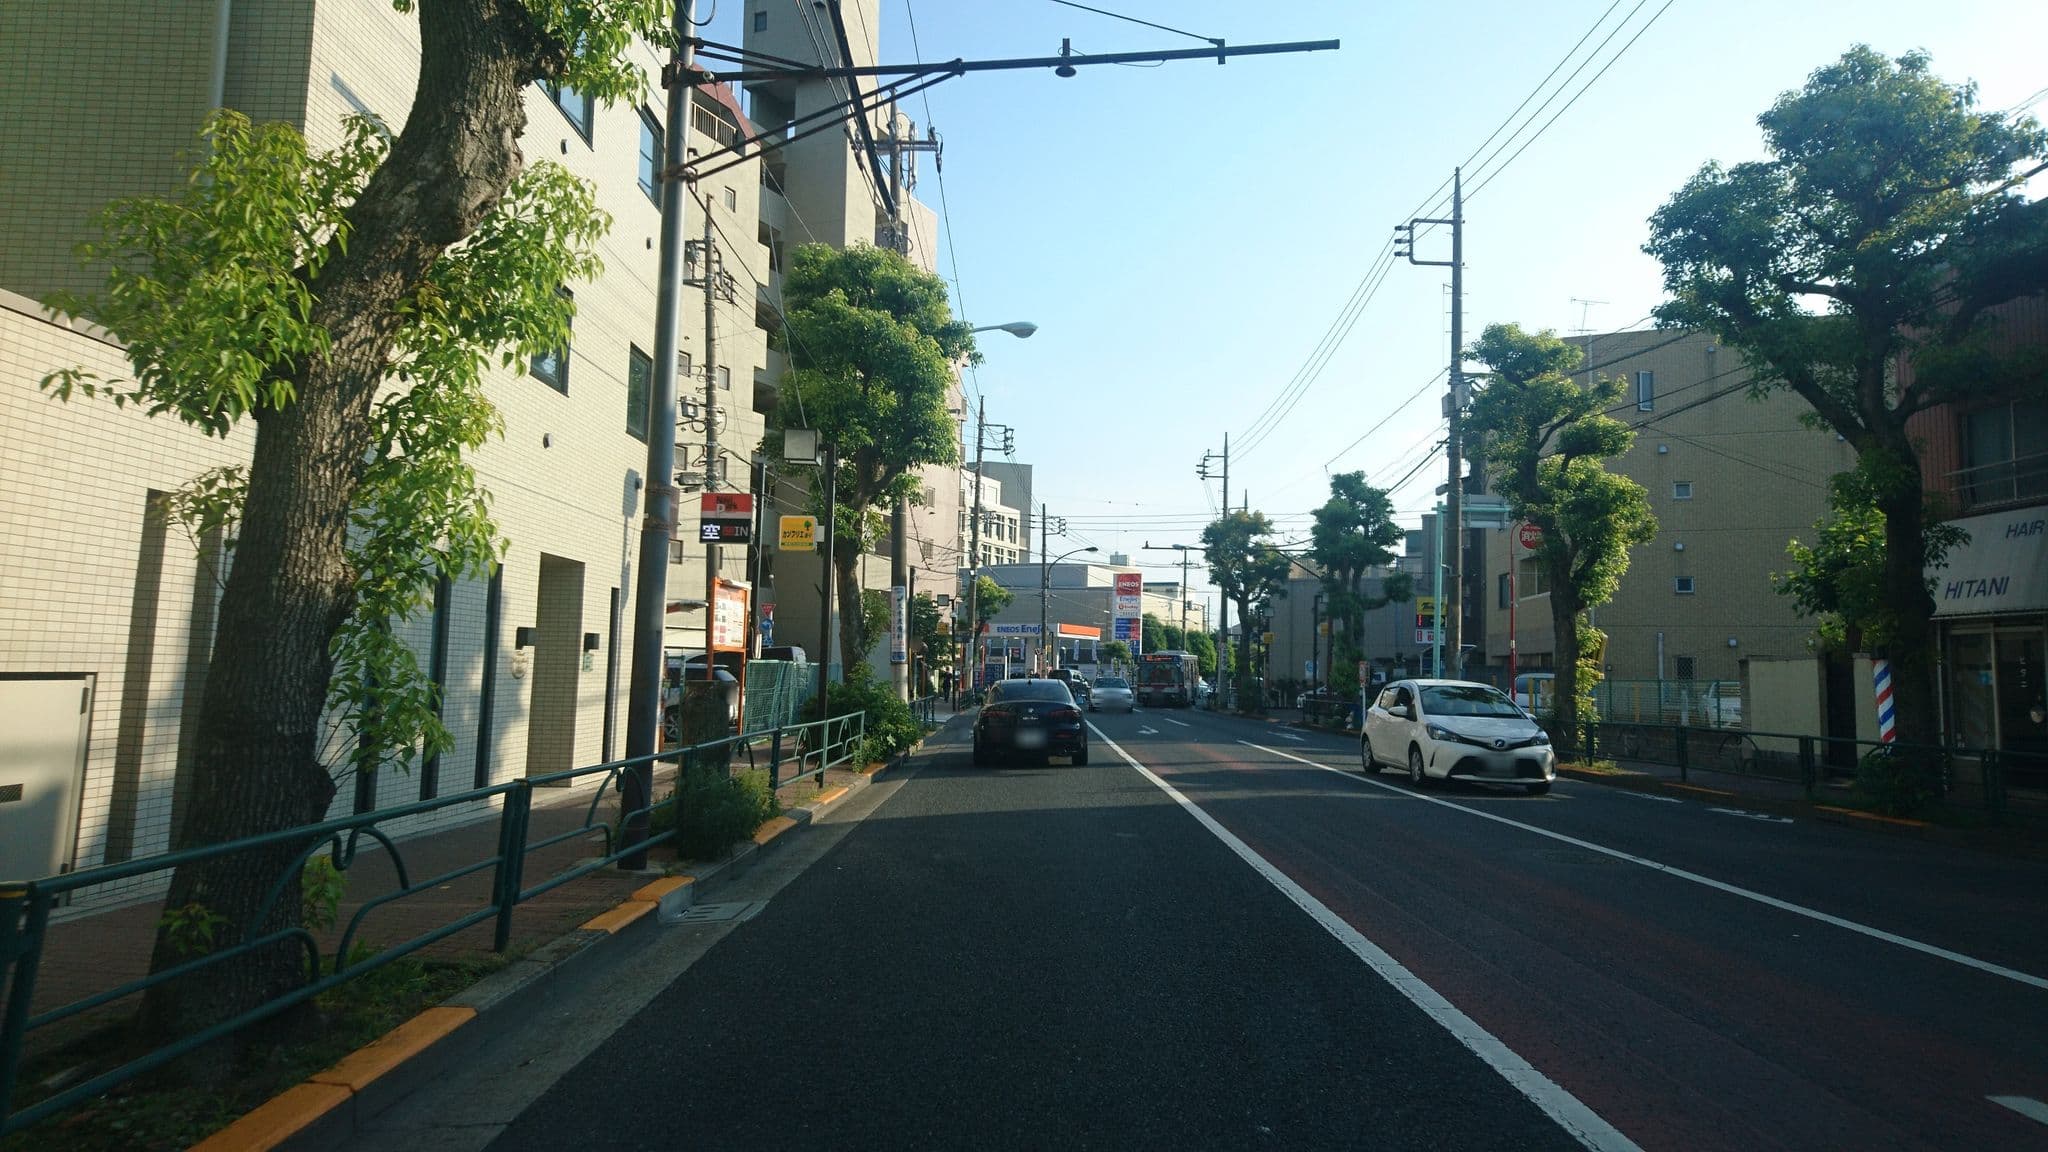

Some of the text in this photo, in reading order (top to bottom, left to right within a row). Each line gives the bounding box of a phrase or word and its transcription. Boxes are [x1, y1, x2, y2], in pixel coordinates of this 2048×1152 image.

[702, 524, 721, 540] 空
[2006, 520, 2045, 539] HAIR
[1945, 576, 2010, 600] HITANI
[996, 625, 1020, 633] ENEOS
